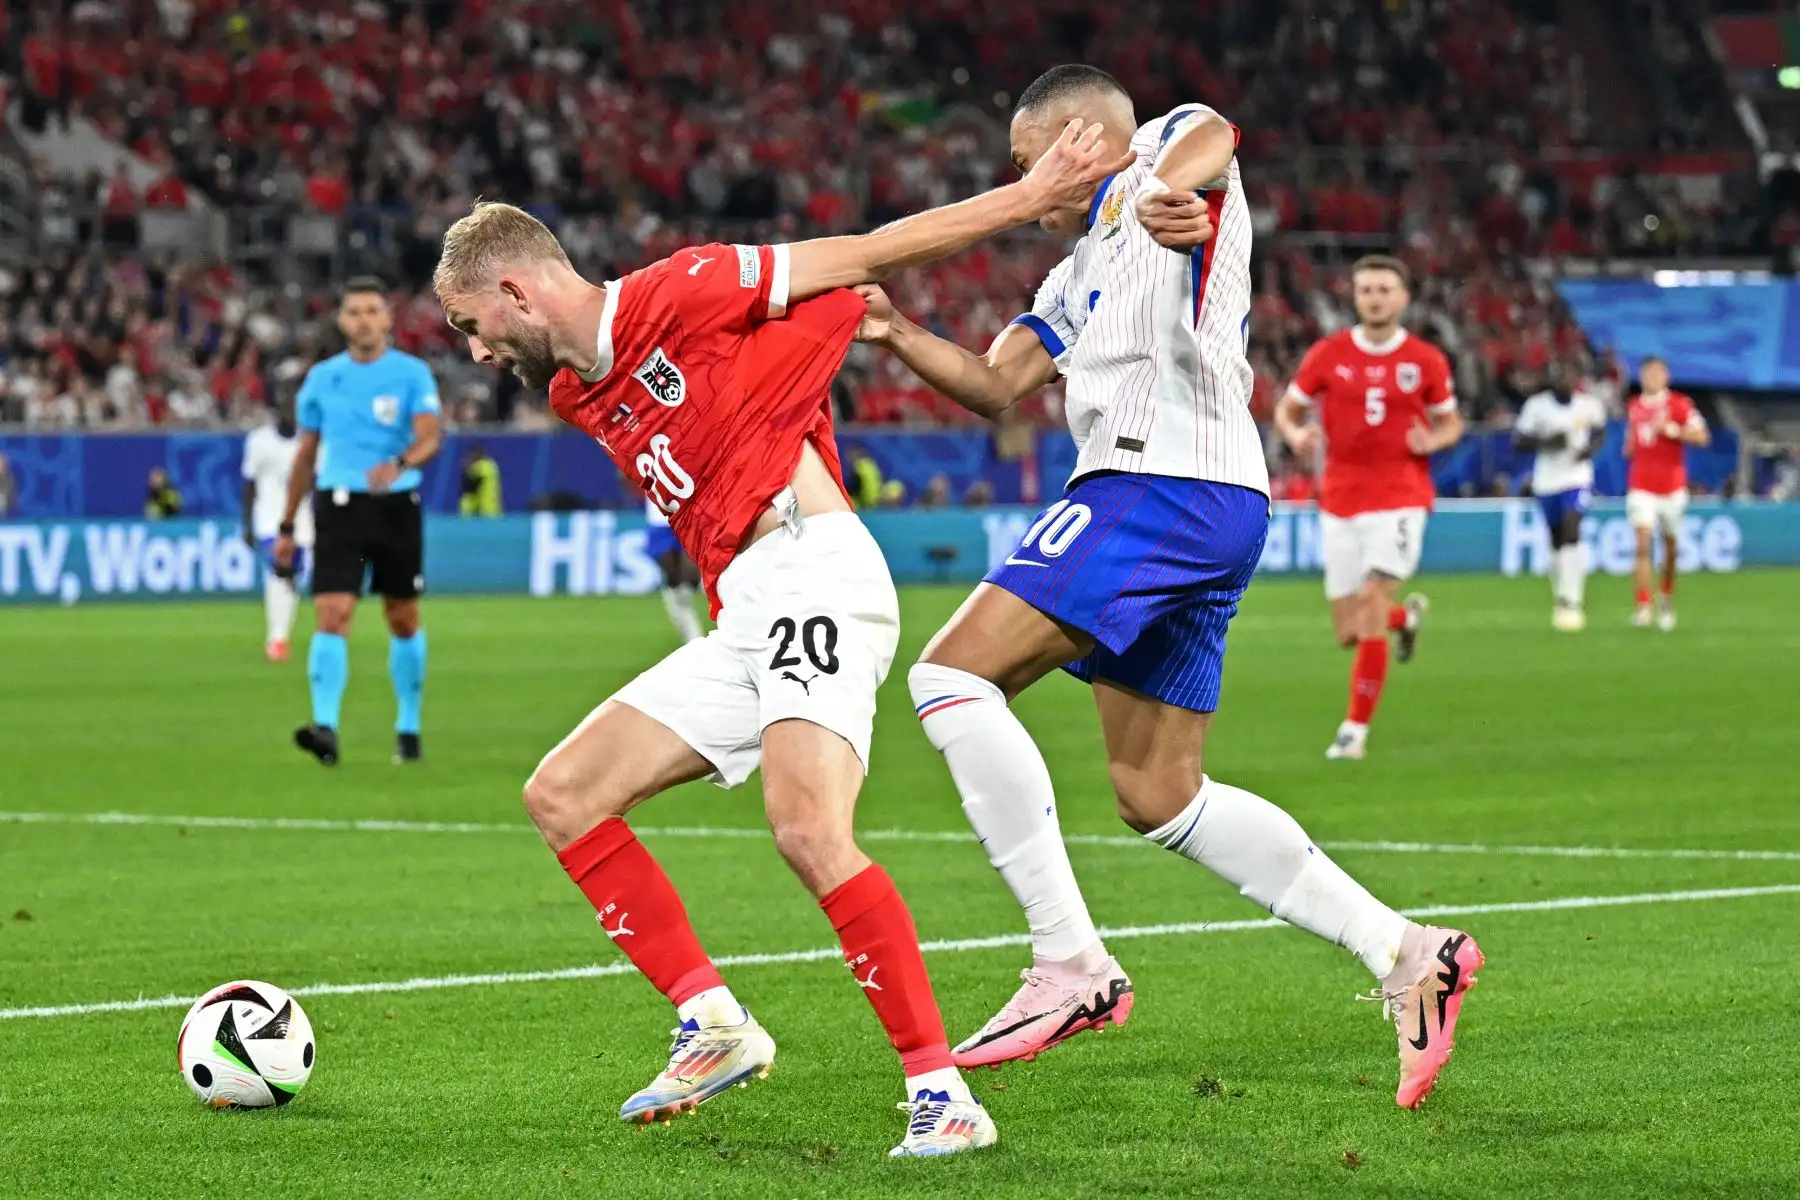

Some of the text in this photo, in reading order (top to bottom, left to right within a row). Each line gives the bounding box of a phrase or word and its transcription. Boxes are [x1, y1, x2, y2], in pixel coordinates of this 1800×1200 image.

[1364, 387, 1387, 427] 5
[636, 433, 695, 513] 20
[84, 520, 255, 593] World
[531, 510, 663, 597] His
[1021, 499, 1092, 558] 10
[767, 615, 840, 675] 20
